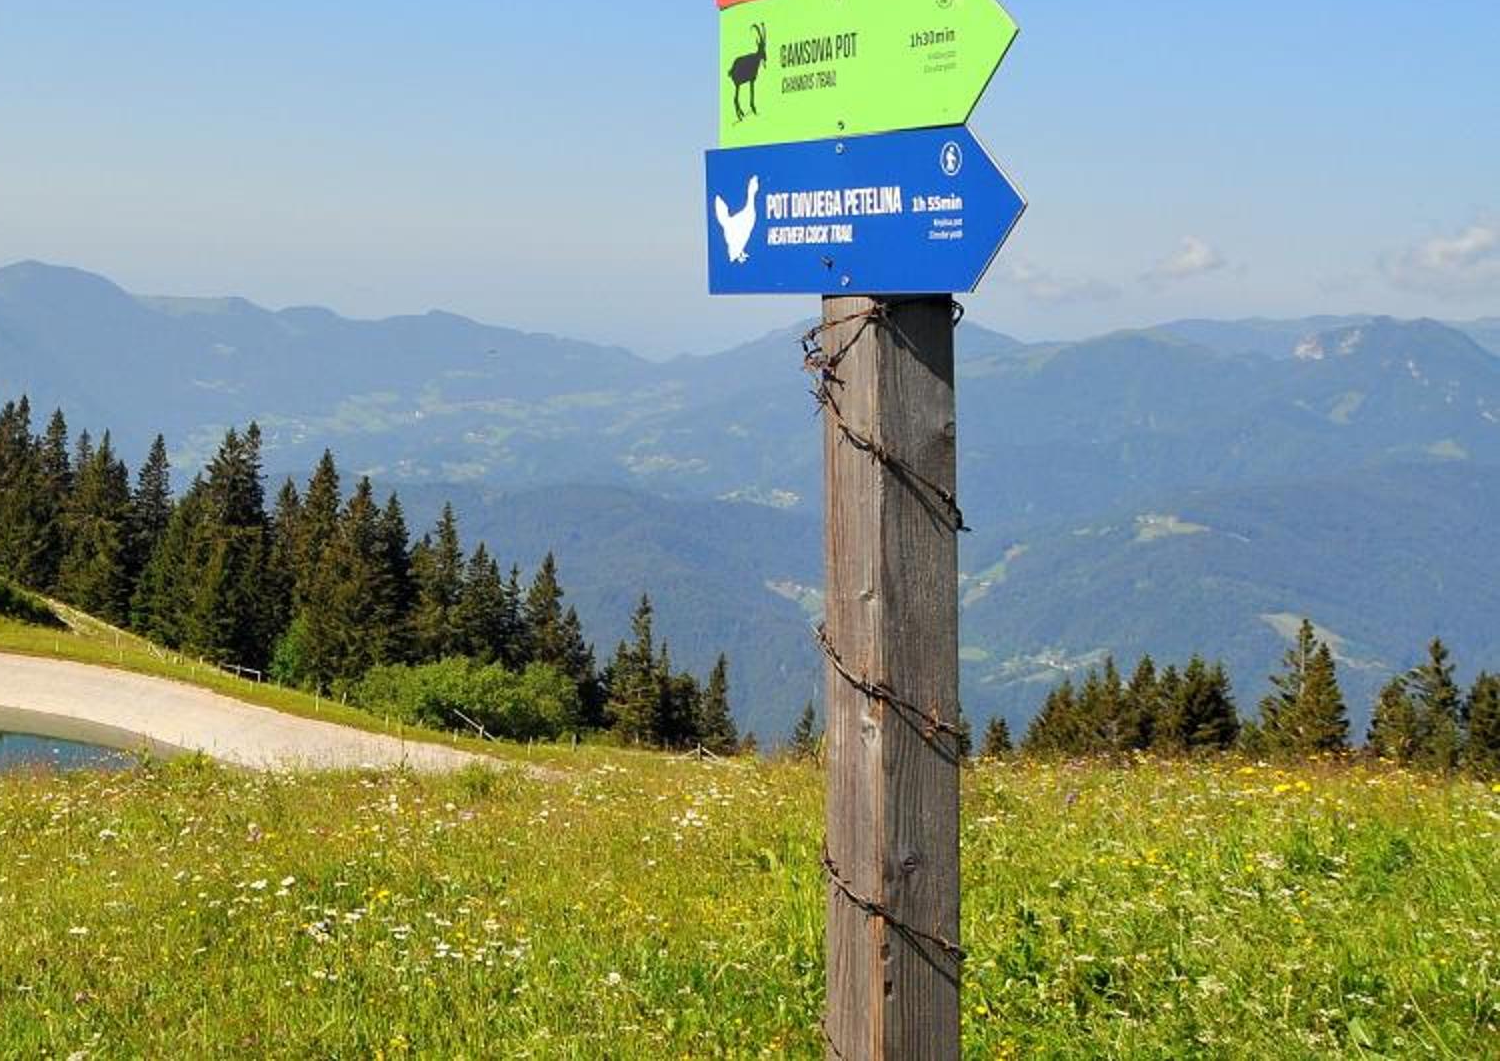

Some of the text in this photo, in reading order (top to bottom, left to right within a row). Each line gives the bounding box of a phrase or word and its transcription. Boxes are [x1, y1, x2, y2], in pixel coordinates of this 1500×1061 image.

[781, 32, 857, 68] GAMSOVA POT
[766, 186, 902, 219] POT DIVJEGA PETELINA
[913, 196, 926, 211] 1h
